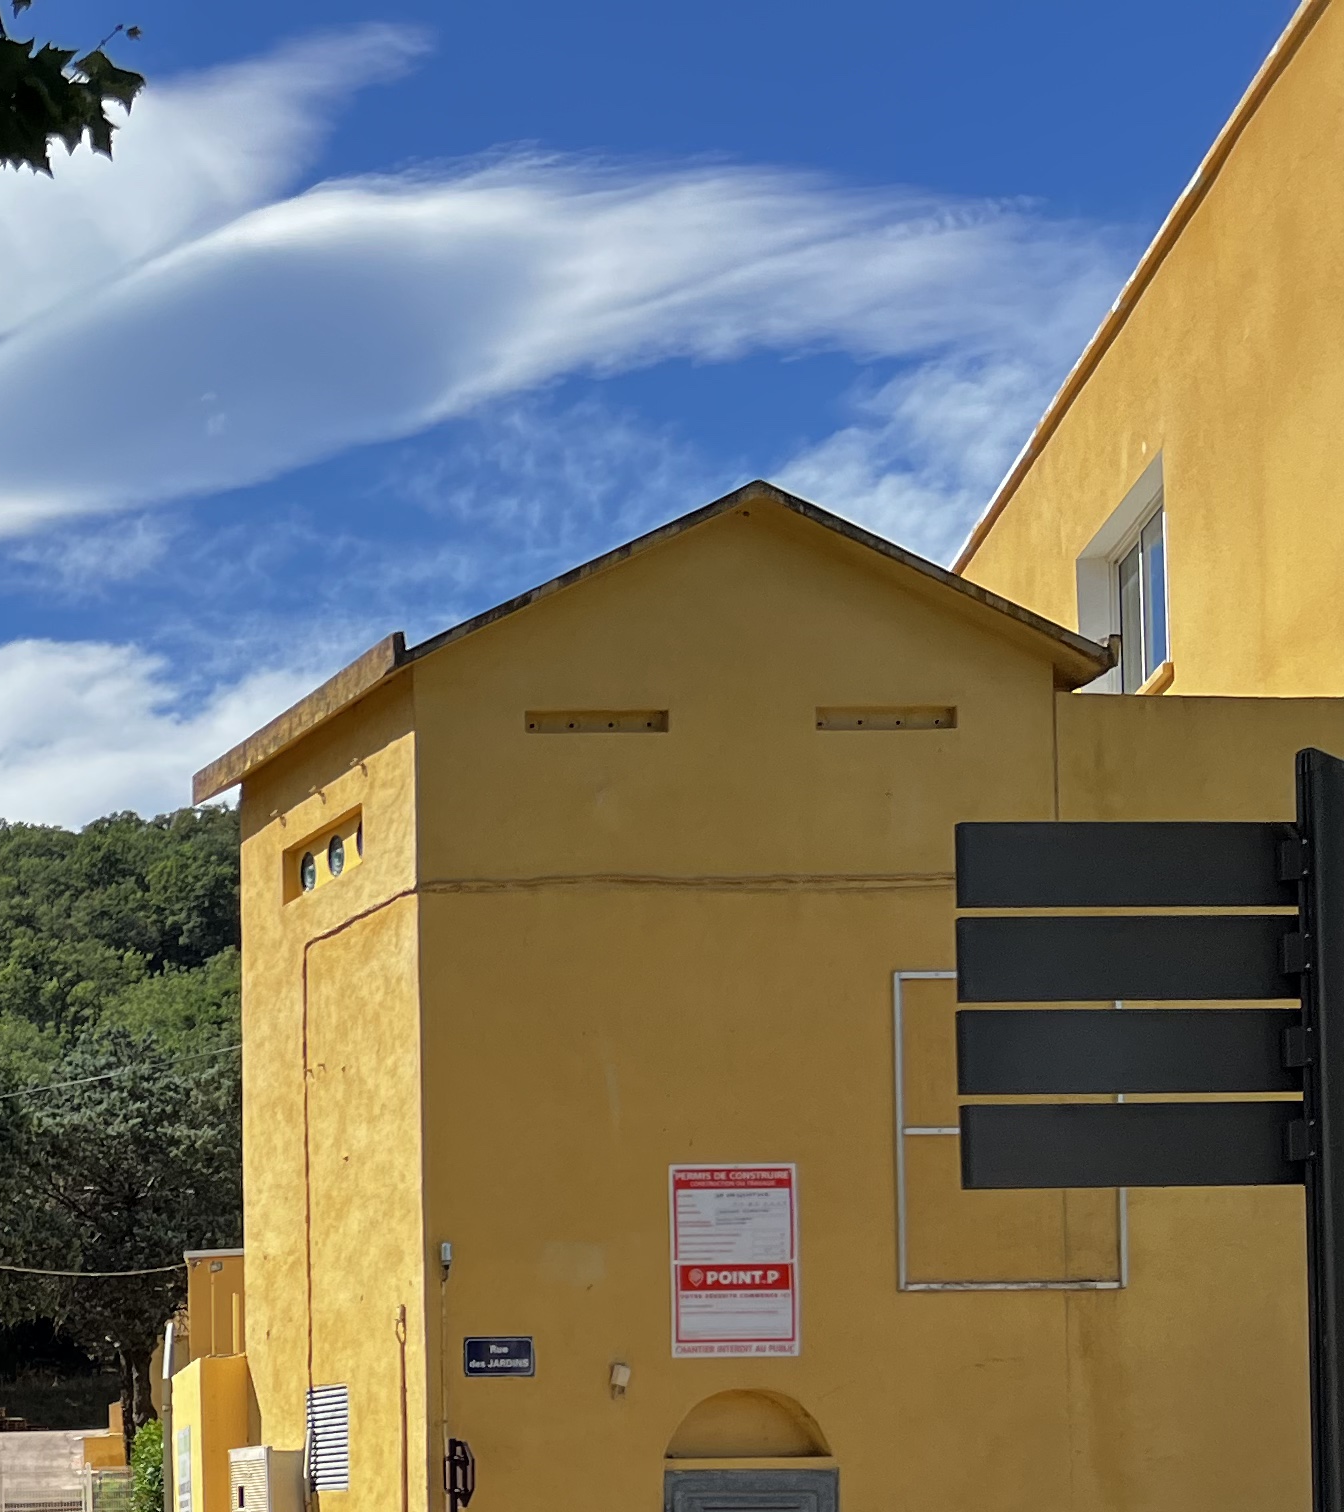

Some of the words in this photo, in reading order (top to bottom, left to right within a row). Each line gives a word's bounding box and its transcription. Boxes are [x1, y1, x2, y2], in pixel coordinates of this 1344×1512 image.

[676, 1172, 711, 1180] PERMIS
[714, 1172, 727, 1180] DE
[729, 1171, 789, 1179] CONSTRUIRE
[706, 1270, 779, 1285] POINT.P
[489, 1345, 509, 1354] Rue
[488, 1359, 529, 1368] JARDINS
